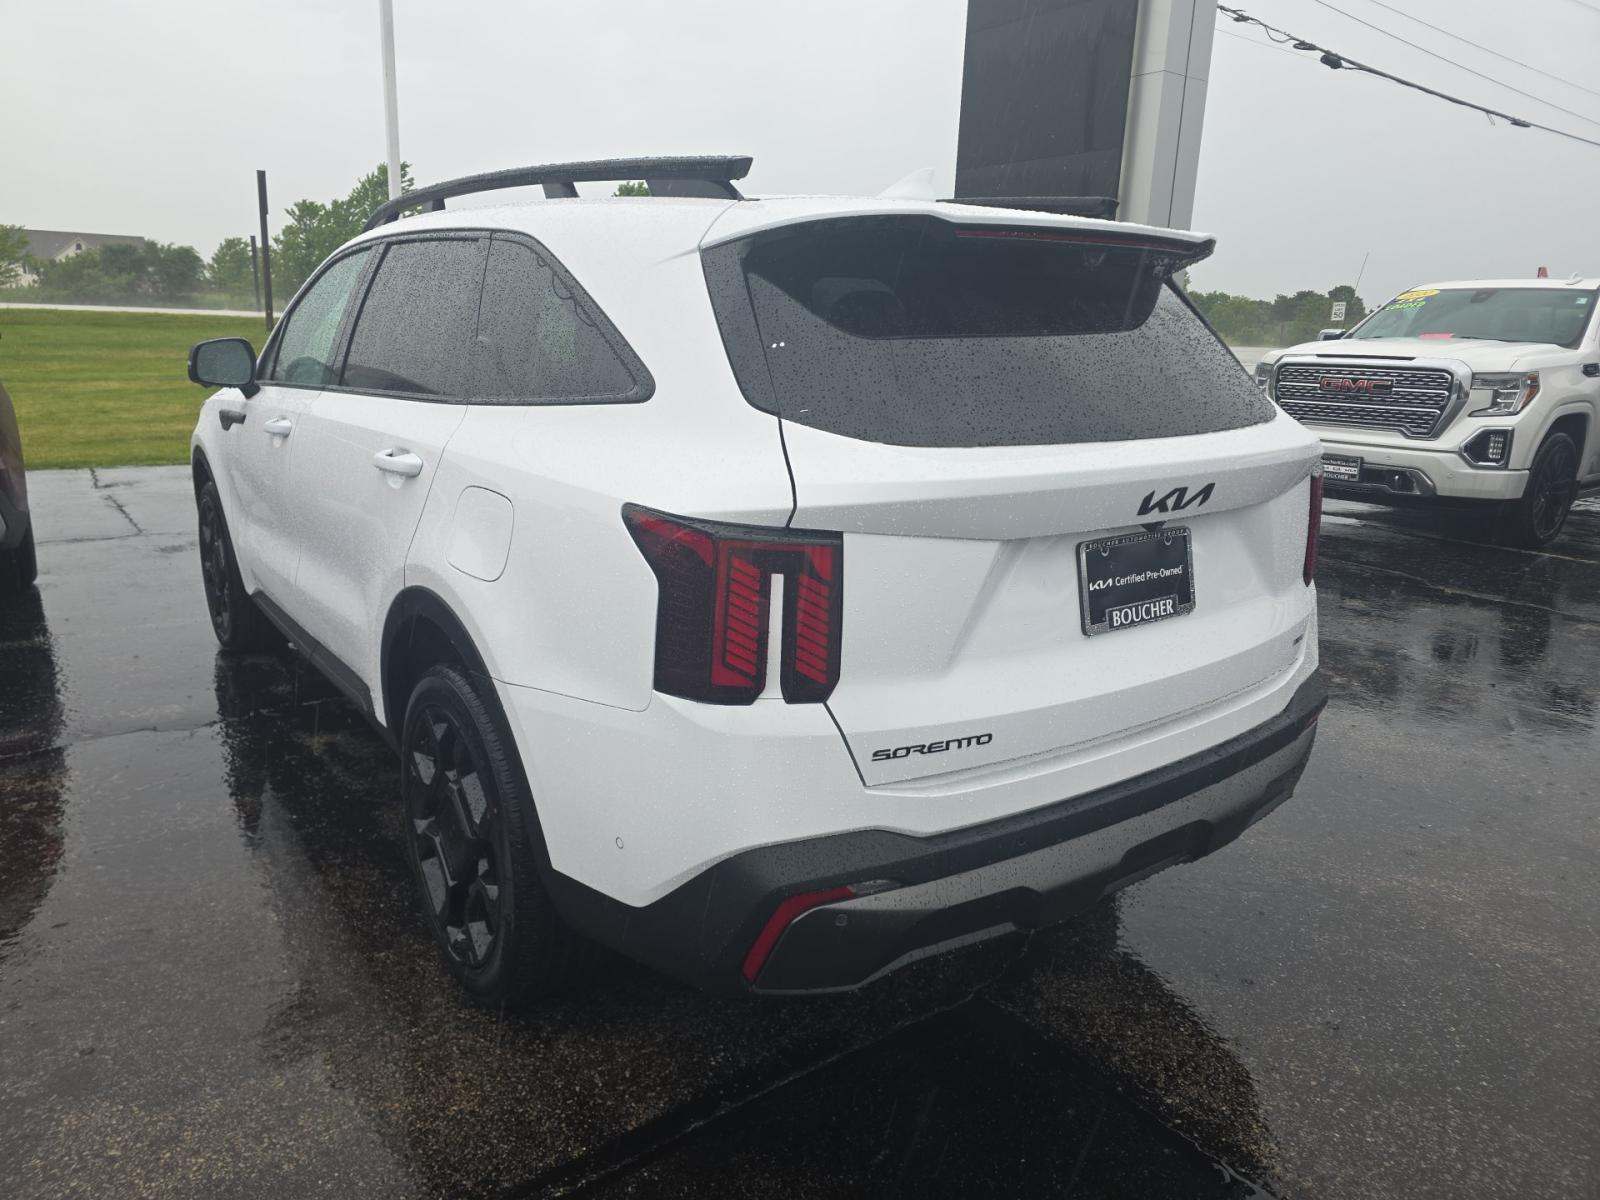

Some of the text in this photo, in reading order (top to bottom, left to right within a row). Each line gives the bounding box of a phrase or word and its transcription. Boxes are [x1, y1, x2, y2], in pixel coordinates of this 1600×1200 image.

[1320, 377, 1392, 395] GMC
[1136, 482, 1216, 516] KIA
[1089, 565, 1183, 591] KIA Certified Pre-Owned
[1112, 599, 1175, 627] BOUCHER
[871, 732, 993, 762] SORENTO
